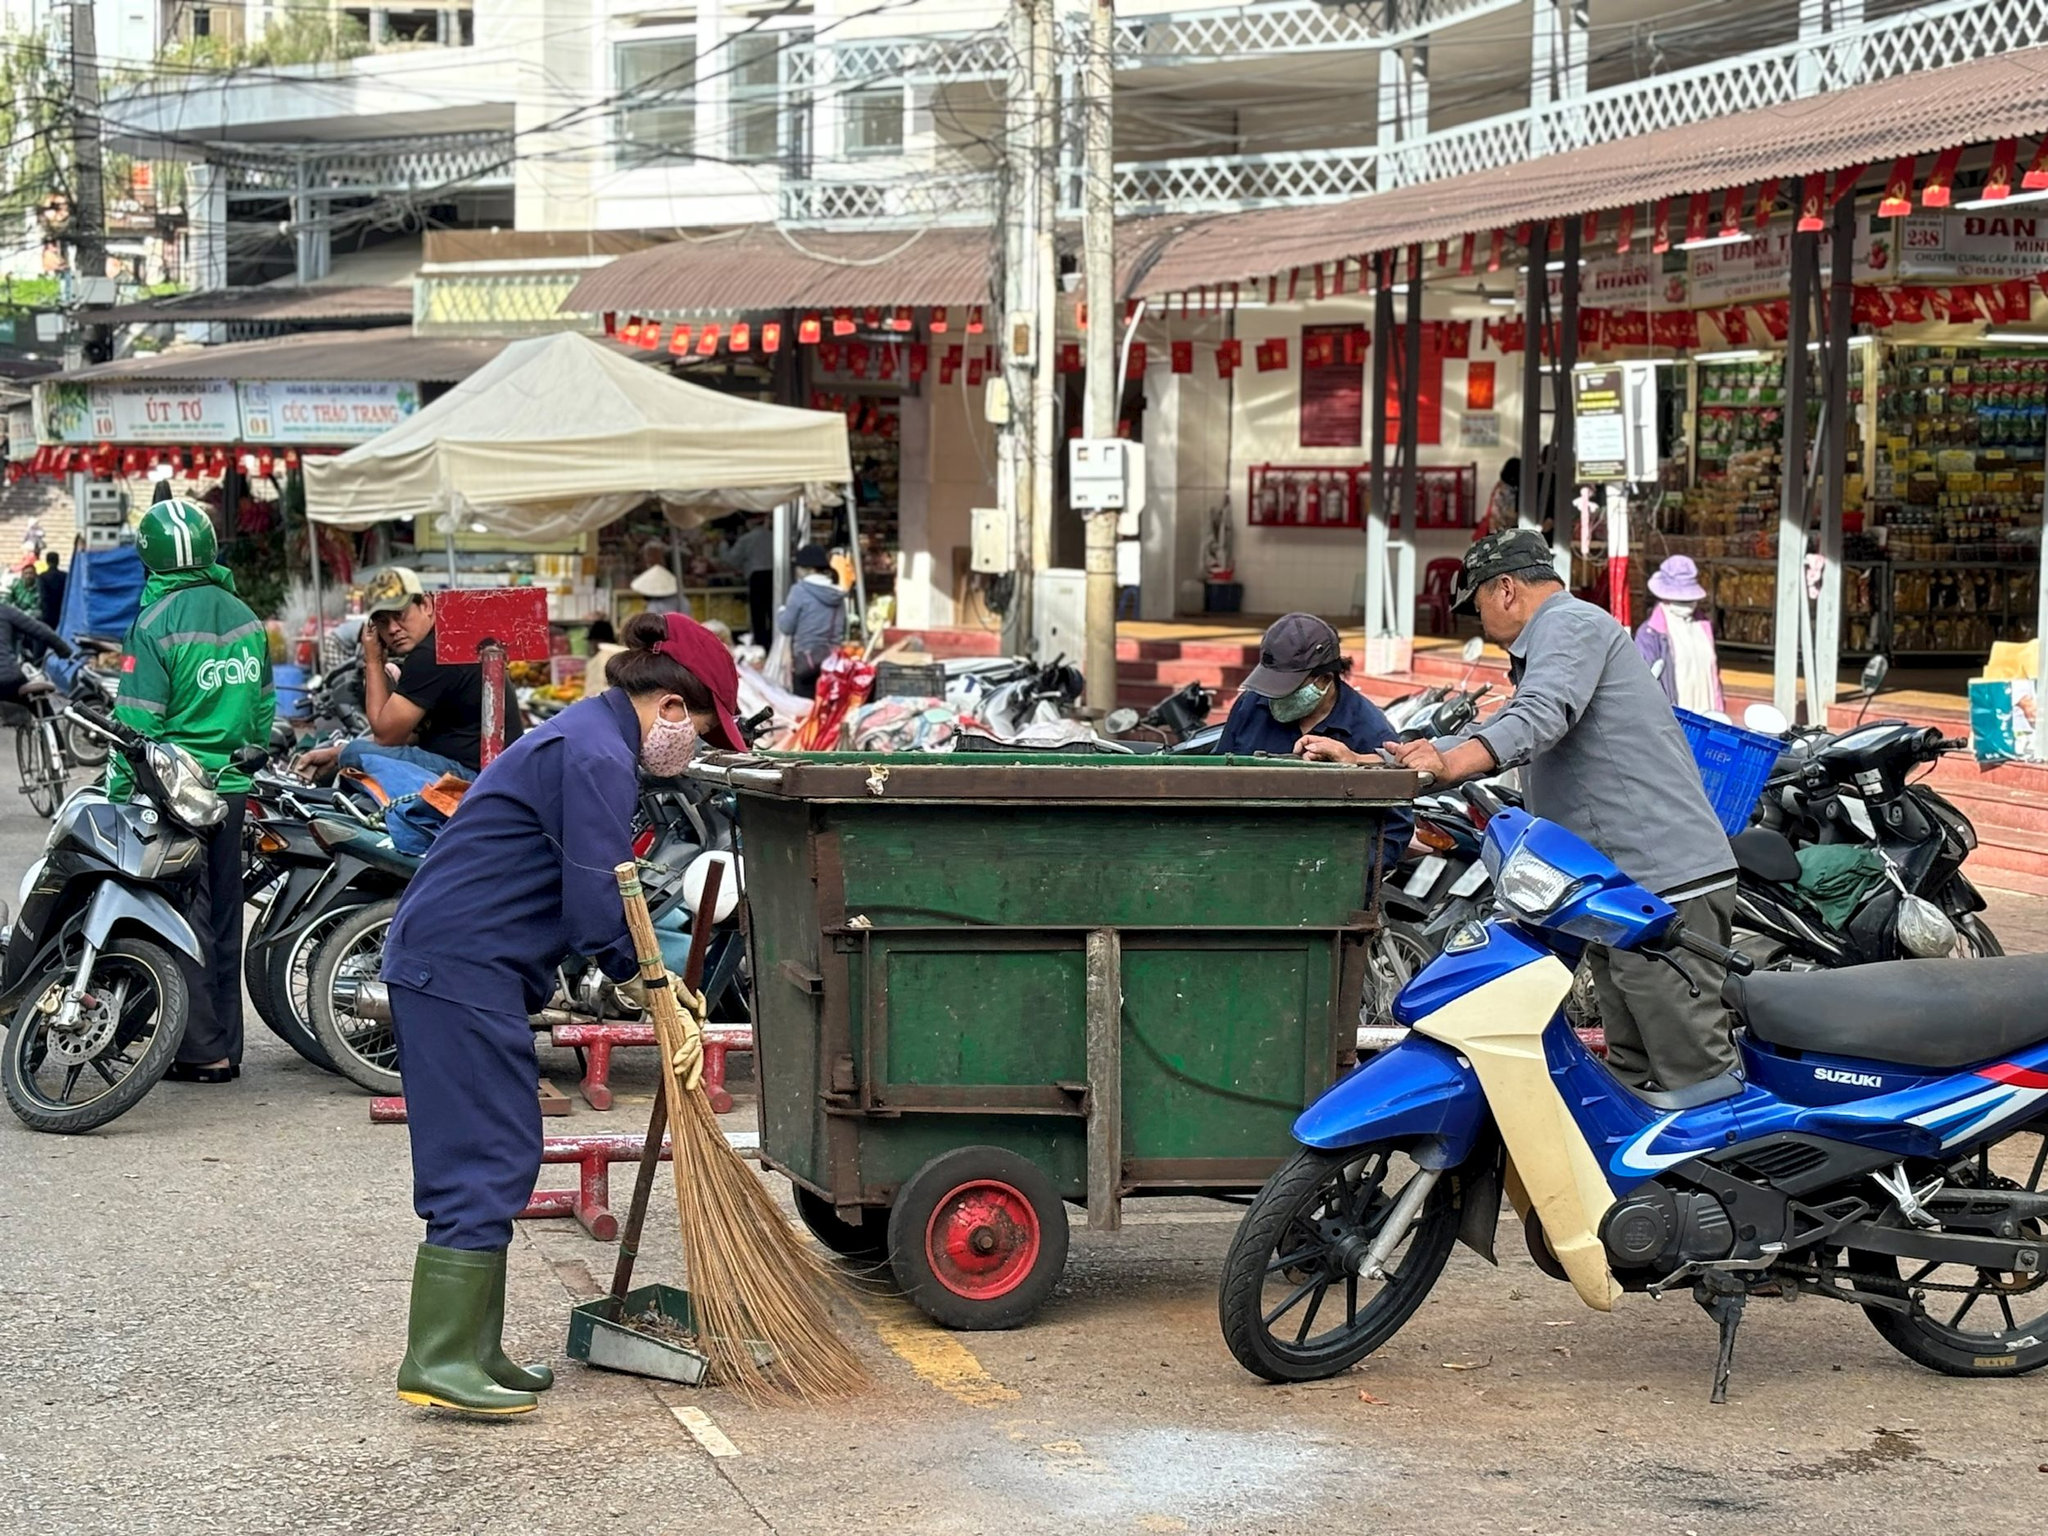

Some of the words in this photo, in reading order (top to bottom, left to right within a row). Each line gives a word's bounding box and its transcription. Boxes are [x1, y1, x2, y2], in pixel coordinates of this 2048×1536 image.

[1964, 217, 2036, 237] ĐAN
[1907, 229, 1939, 247] 238
[1915, 252, 1956, 262] CHUYÊN
[1958, 254, 1985, 263] CUNG
[1975, 266, 2004, 276] 0836
[2008, 267, 2026, 277] 191
[145, 397, 172, 422] ÚT
[282, 400, 308, 423] CÚC
[313, 398, 349, 423] THẢO
[351, 404, 399, 423] TRANG
[96, 418, 112, 434] 10
[250, 418, 268, 433] 01
[197, 646, 260, 690] Grab
[1814, 1067, 1882, 1088] SUZUKI
